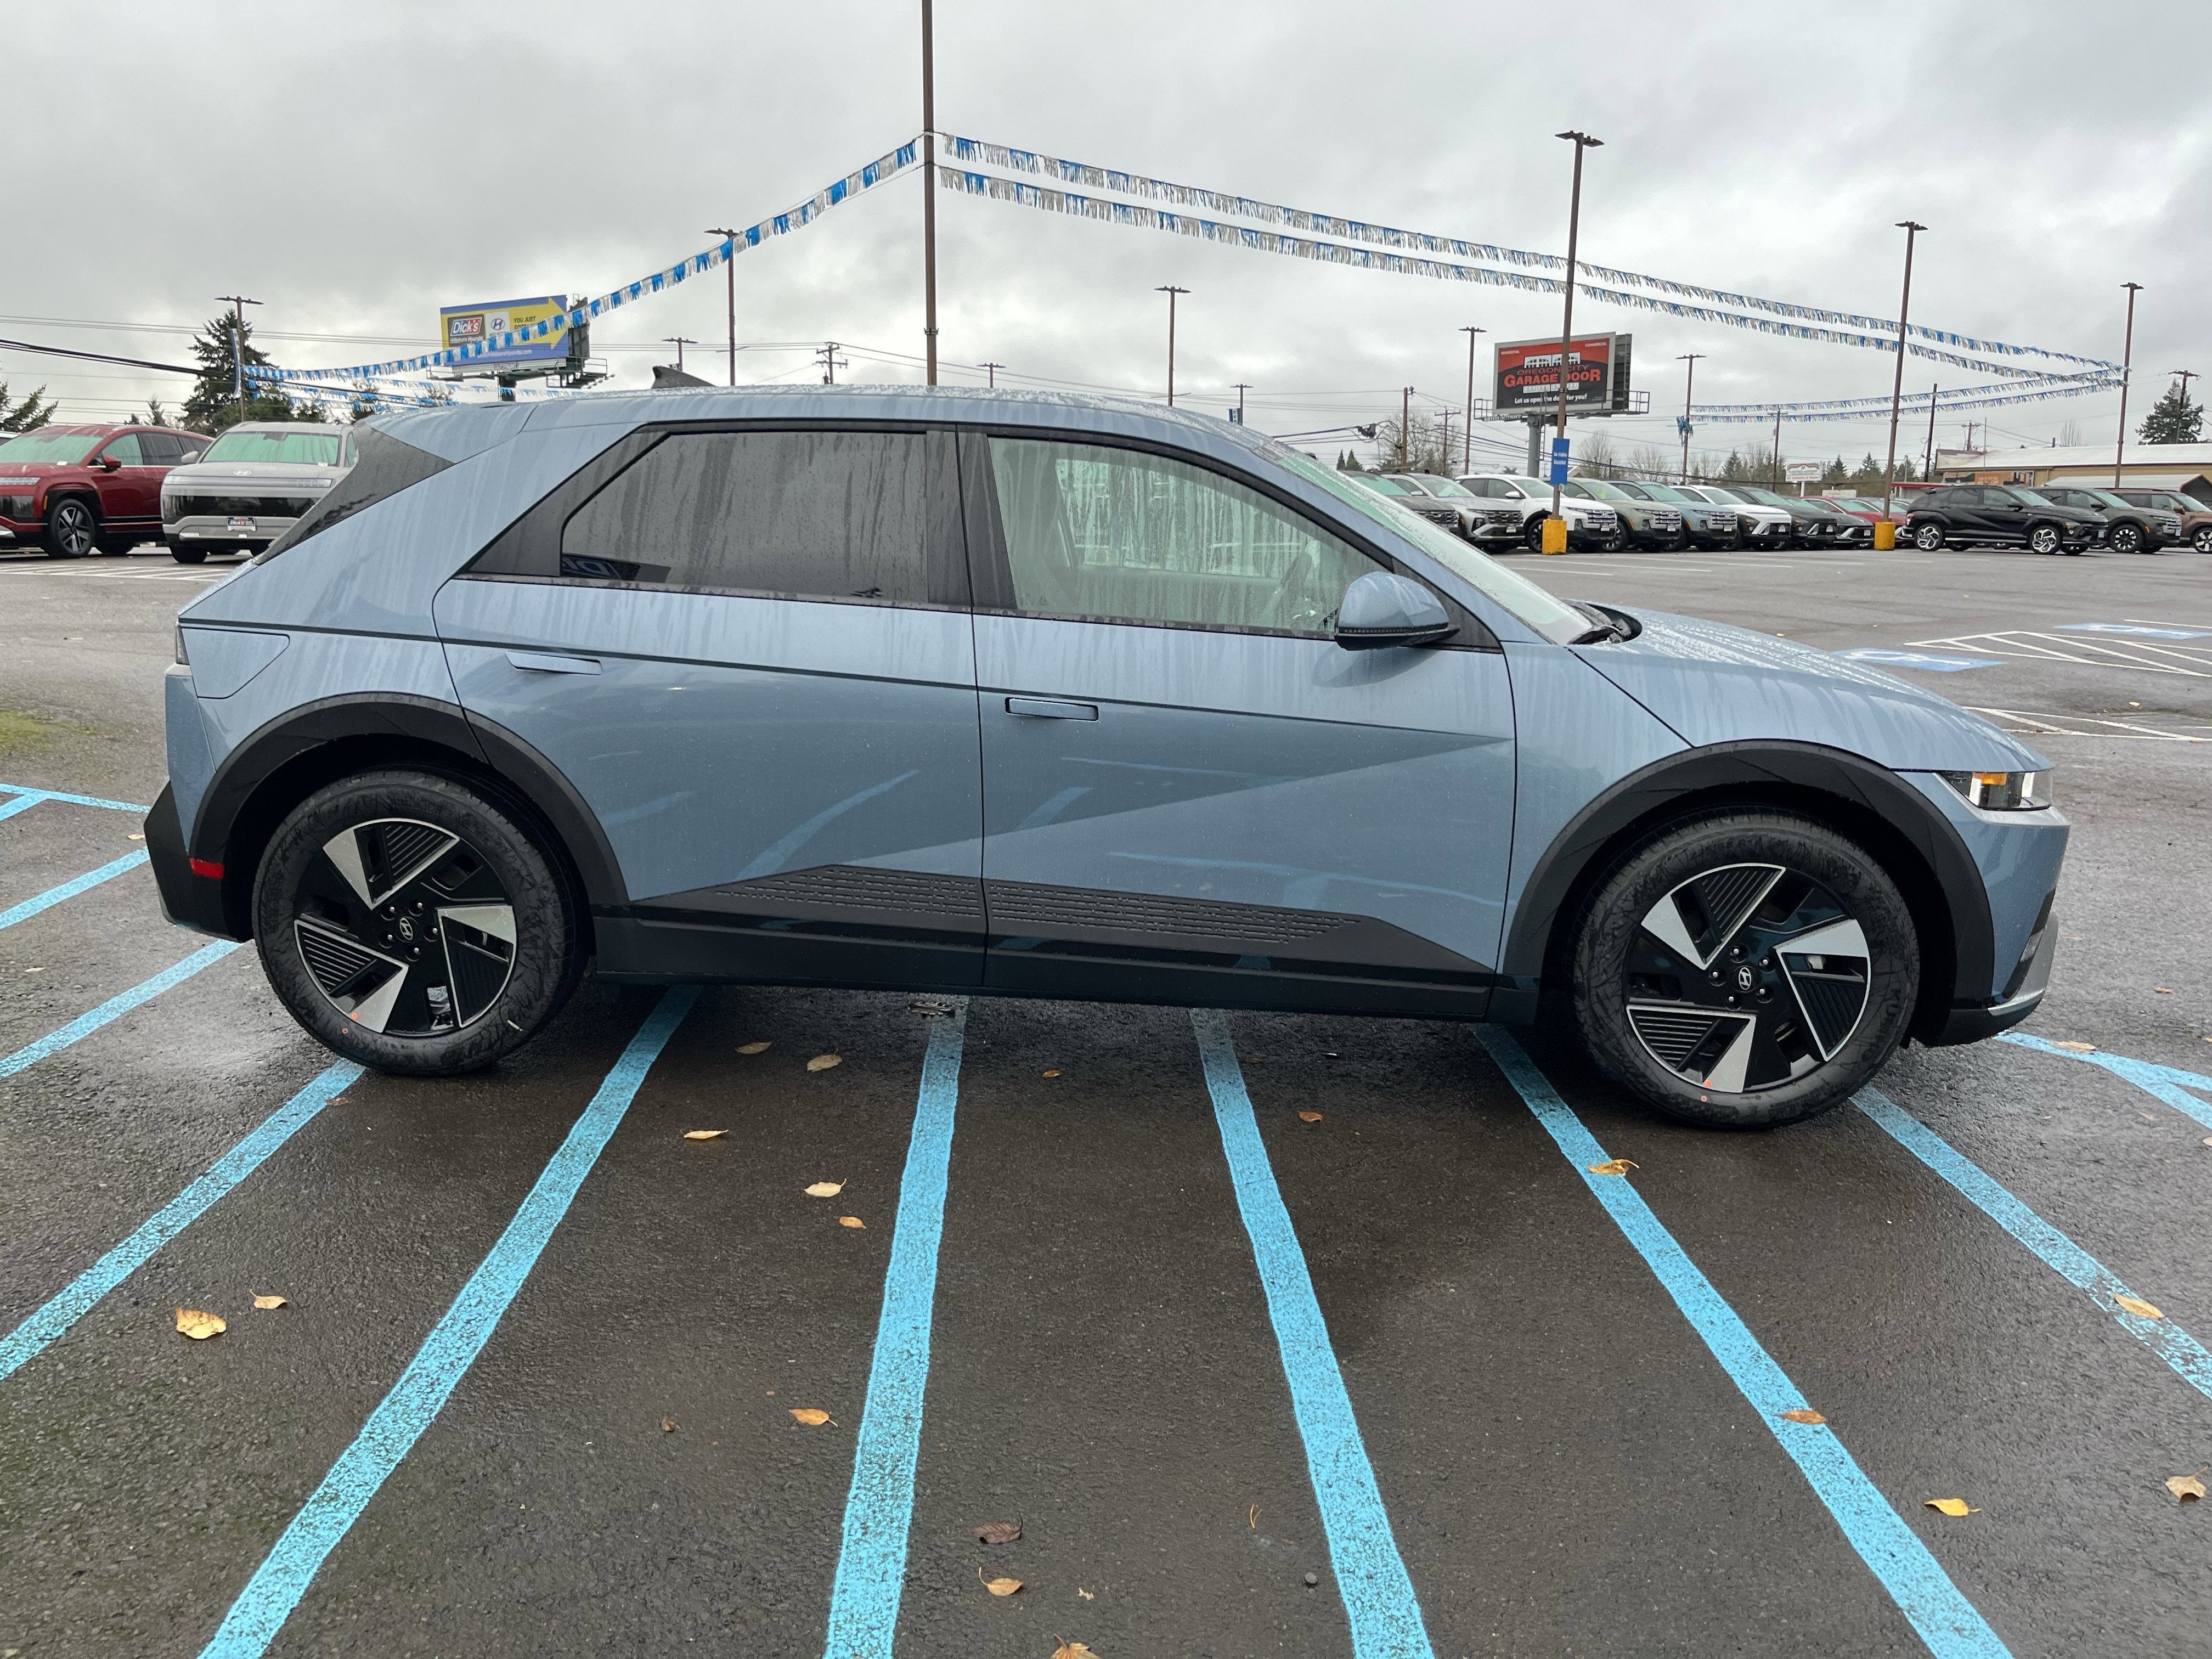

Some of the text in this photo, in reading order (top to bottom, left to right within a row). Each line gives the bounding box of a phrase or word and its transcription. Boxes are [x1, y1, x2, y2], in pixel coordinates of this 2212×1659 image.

[453, 320, 479, 334] Dick's
[1517, 366, 1561, 375] OREGON
[1504, 374, 1558, 388] GARAGE
